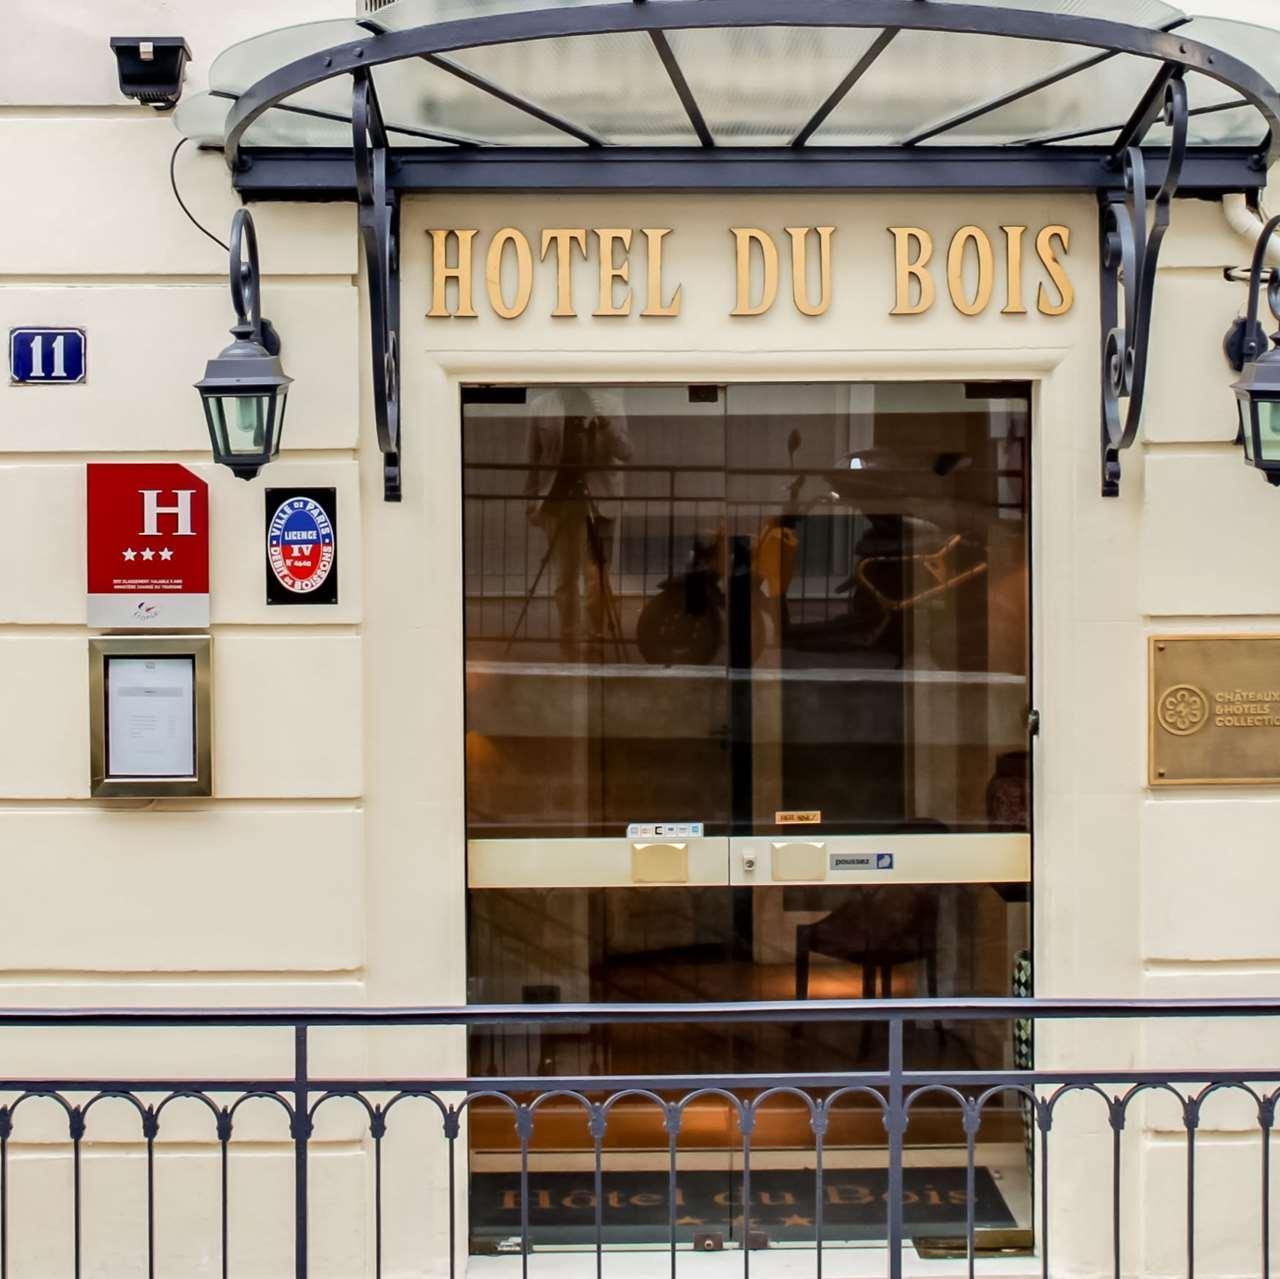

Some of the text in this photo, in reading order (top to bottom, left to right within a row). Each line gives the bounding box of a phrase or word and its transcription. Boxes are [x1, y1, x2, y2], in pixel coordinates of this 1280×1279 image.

[424, 223, 1076, 320] HOTEL DU BOIS
[30, 335, 67, 377] 11
[138, 489, 197, 536] H
[271, 504, 293, 536] VILLE
[305, 501, 331, 535] PARIS
[284, 530, 318, 540] LICENCE
[291, 544, 312, 556] IV
[294, 545, 332, 590] BOISSONS
[1215, 689, 1280, 702] CHÂTEAUX
[823, 1184, 978, 1206] Bois
